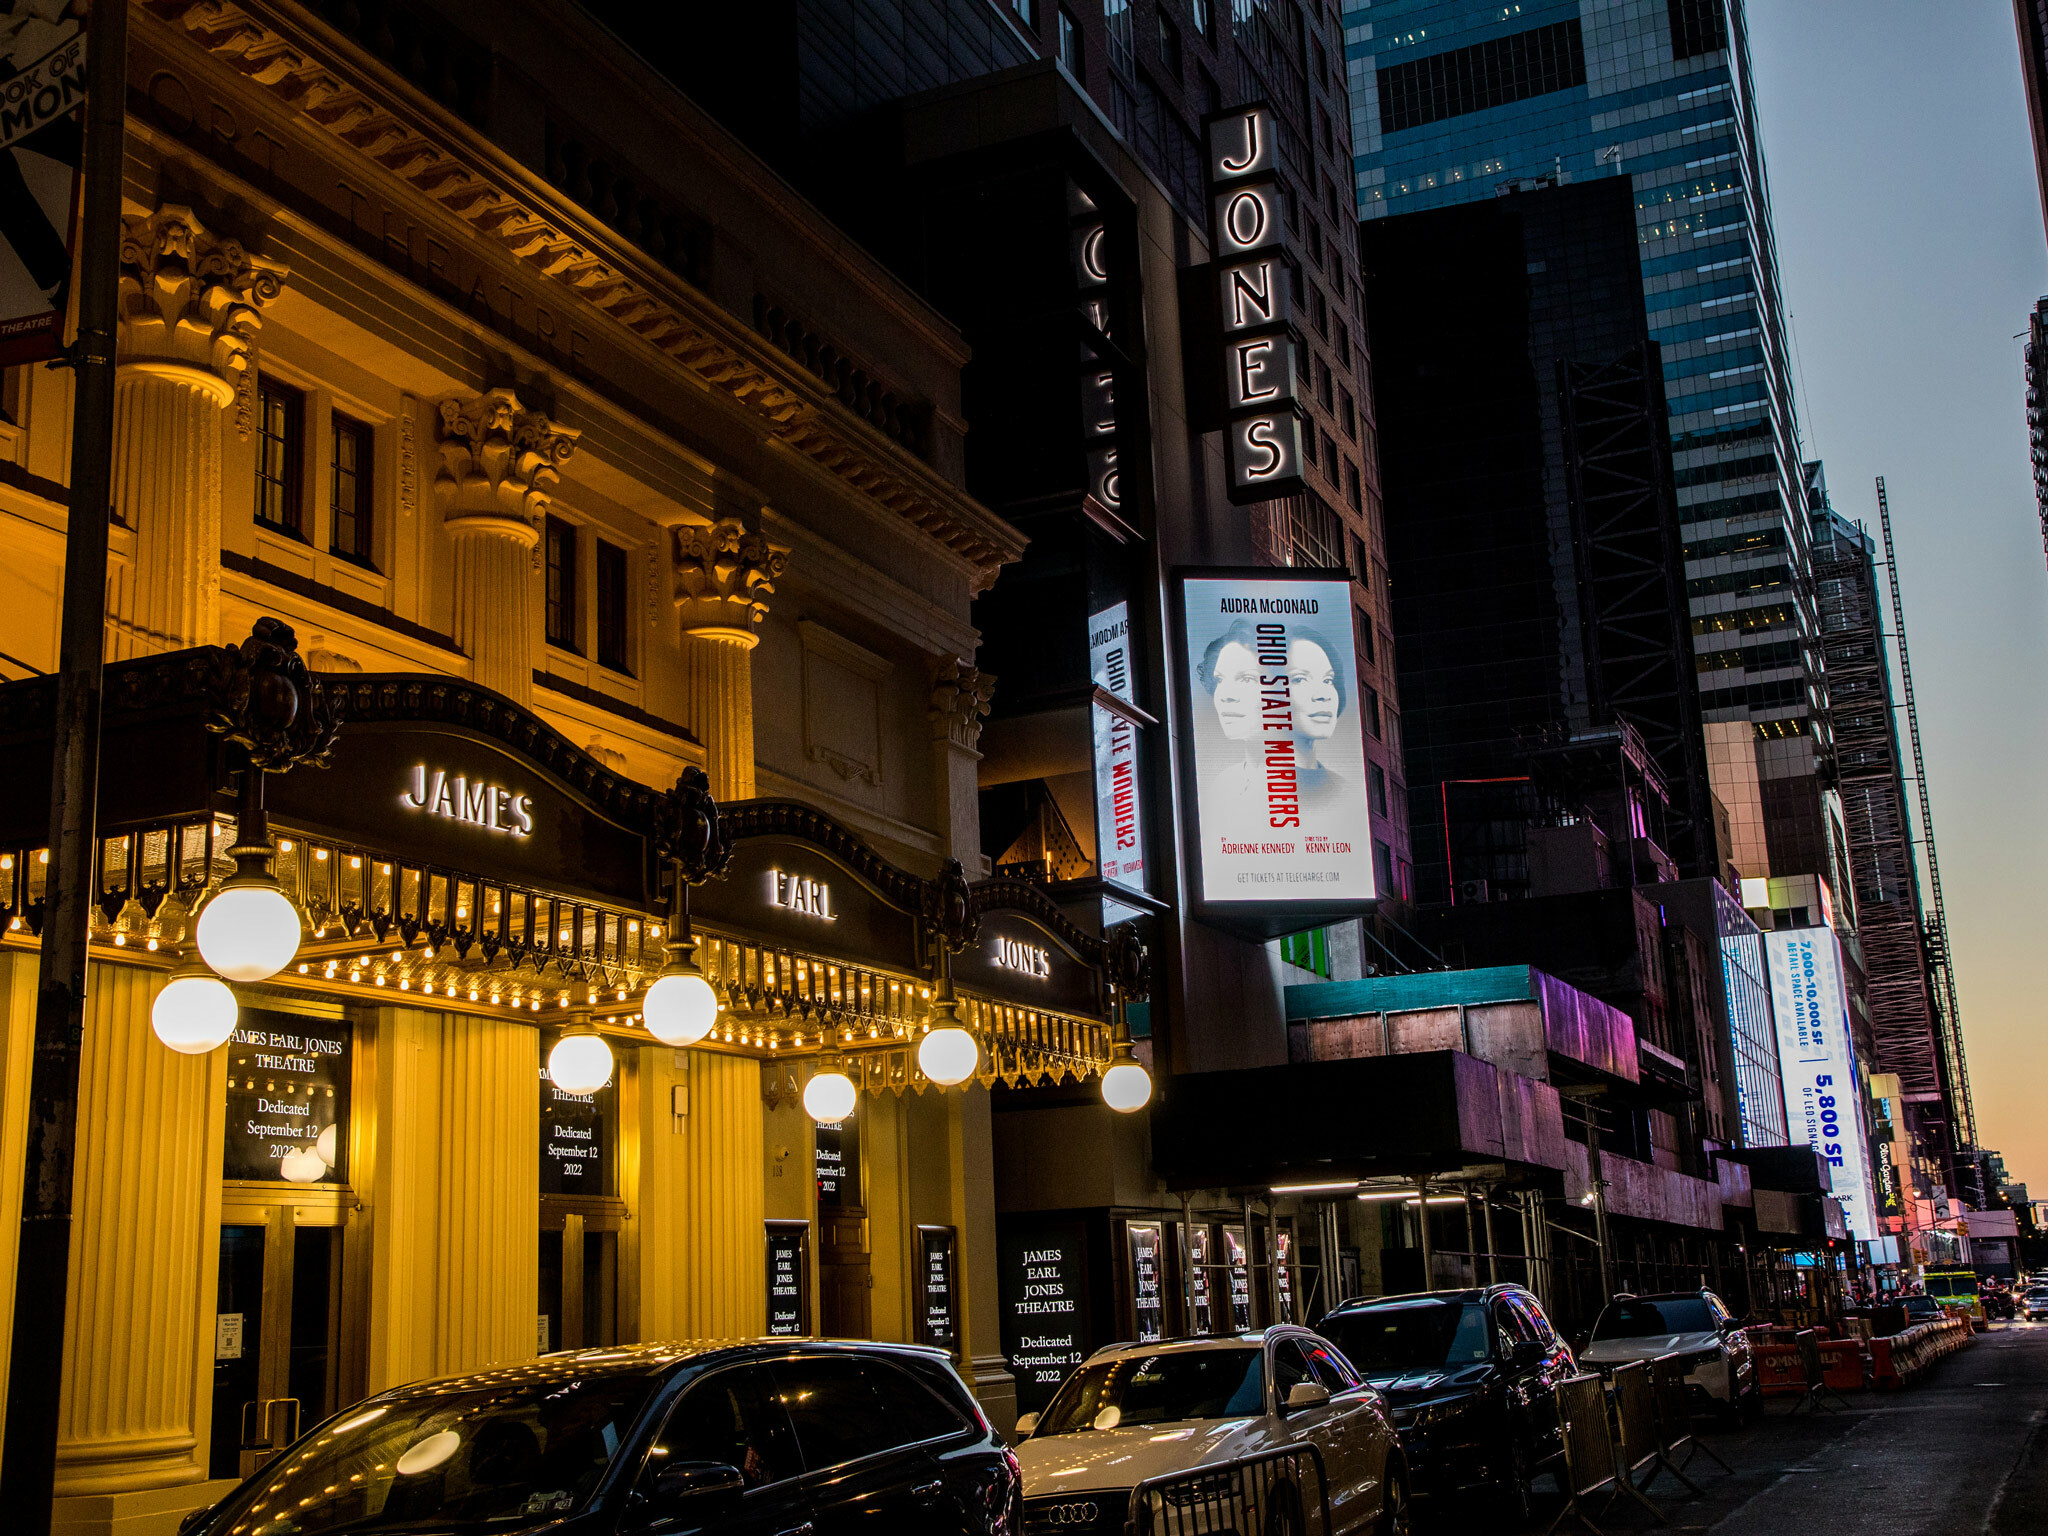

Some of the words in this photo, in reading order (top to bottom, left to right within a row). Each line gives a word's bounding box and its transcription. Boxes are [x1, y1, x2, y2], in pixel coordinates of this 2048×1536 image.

[0, 68, 42, 109] OK
[49, 42, 79, 77] OF
[0, 63, 86, 142] MON
[1221, 113, 1282, 480] JONES
[1, 316, 52, 335] THEATRE
[1220, 597, 1257, 614] AUDRA
[1259, 598, 1319, 615] McDONALD
[1255, 623, 1288, 666] OHIO
[1259, 675, 1293, 731] STATE
[1264, 740, 1300, 828] MURDERS
[399, 765, 533, 837] JAMES
[1221, 843, 1260, 854] ADRIENNE
[1261, 843, 1295, 854] KENNEDY
[1305, 842, 1330, 854] KENNY
[1332, 842, 1351, 854] LEON
[1237, 872, 1249, 883] GET
[1250, 872, 1275, 883] TICKETS
[1276, 872, 1284, 883] AT
[1285, 871, 1340, 883] TELECHARGE.COM
[768, 869, 839, 921] EARL
[990, 937, 1050, 979] JONES
[1787, 942, 1797, 969] RETAIL
[1791, 970, 1802, 996] SPACE
[1799, 941, 1821, 1028] 7,000-10,000
[1812, 1030, 1824, 1045] SF
[1794, 997, 1809, 1047] AVAILABLE
[269, 1033, 303, 1050] EARL
[303, 1037, 342, 1055] JONES
[255, 1053, 316, 1073] THEATRE
[1802, 1087, 1812, 1098] OF
[257, 1098, 310, 1116] Dedicated
[1804, 1099, 1815, 1115] LED
[1814, 1074, 1839, 1138] 5,800
[247, 1120, 303, 1139] September
[305, 1124, 318, 1138] 12
[554, 1125, 592, 1140] Dedicated
[1807, 1118, 1820, 1152] SIGNAG
[548, 1143, 588, 1160] September
[588, 1147, 598, 1158] 12
[816, 1149, 842, 1162] Dedicated
[1824, 1142, 1844, 1168] SF
[1879, 1143, 1889, 1164] Olive
[563, 1163, 583, 1176] 2022
[816, 1165, 838, 1179] eptember
[838, 1166, 846, 1177] 12
[822, 1181, 836, 1192] 2022
[1880, 1164, 1894, 1196] Garden
[776, 1250, 793, 1261] JAMES
[929, 1252, 944, 1262] JAMES
[1022, 1249, 1062, 1266] JAMES
[1137, 1247, 1153, 1260] JAMES
[777, 1261, 792, 1271] EARL
[931, 1263, 943, 1271] EARL
[1027, 1266, 1061, 1280] EARL
[1139, 1263, 1154, 1274] EARL
[776, 1274, 793, 1286] JONES
[930, 1274, 944, 1283] JONES
[773, 1286, 798, 1296] THEATRE
[927, 1285, 947, 1293] THEATRE
[1023, 1284, 1064, 1300] JONES
[1015, 1300, 1075, 1314] THEATRE
[1136, 1297, 1161, 1309] THEATRE
[1021, 1335, 1073, 1349] Dedicated
[1012, 1352, 1067, 1369] September
[1069, 1352, 1082, 1364] 12
[1035, 1370, 1061, 1383] 2022
